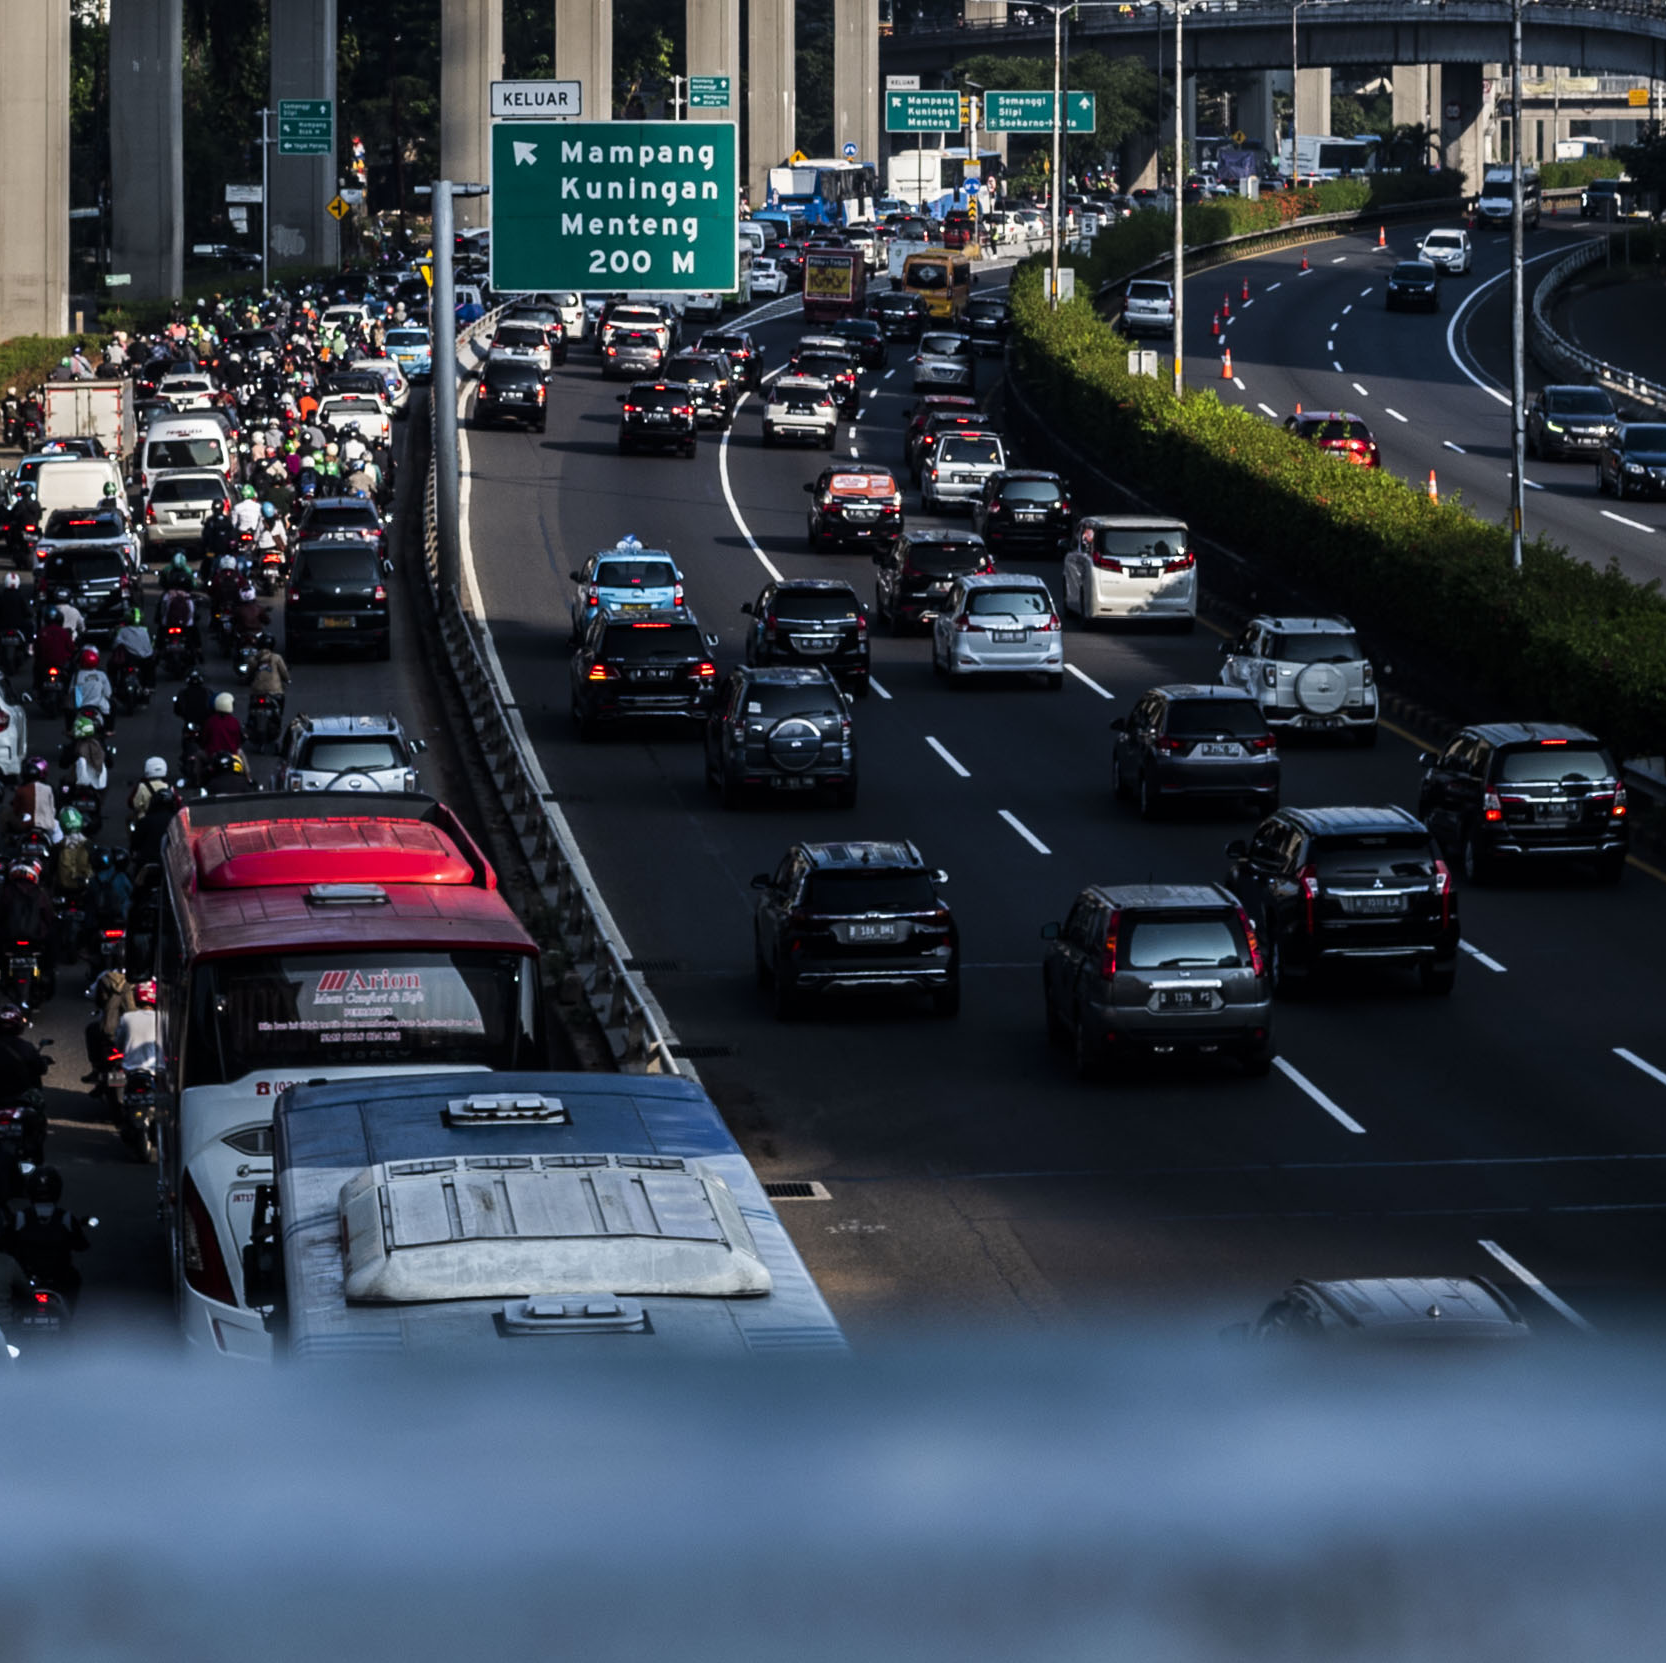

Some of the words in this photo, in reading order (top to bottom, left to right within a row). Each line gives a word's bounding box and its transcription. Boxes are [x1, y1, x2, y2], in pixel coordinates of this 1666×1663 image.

[503, 91, 568, 107] KELUAR
[907, 96, 954, 107] Mampang
[998, 96, 1046, 108] Semanggi
[907, 107, 956, 118] Kuningan
[998, 107, 1022, 117] Slipi
[907, 118, 951, 128] Menteng
[561, 140, 715, 170] Mampang
[561, 177, 718, 207] Kuningan
[561, 213, 698, 243] Menteng
[588, 249, 652, 273] 200
[672, 250, 695, 274] M
[346, 968, 421, 991] Arion
